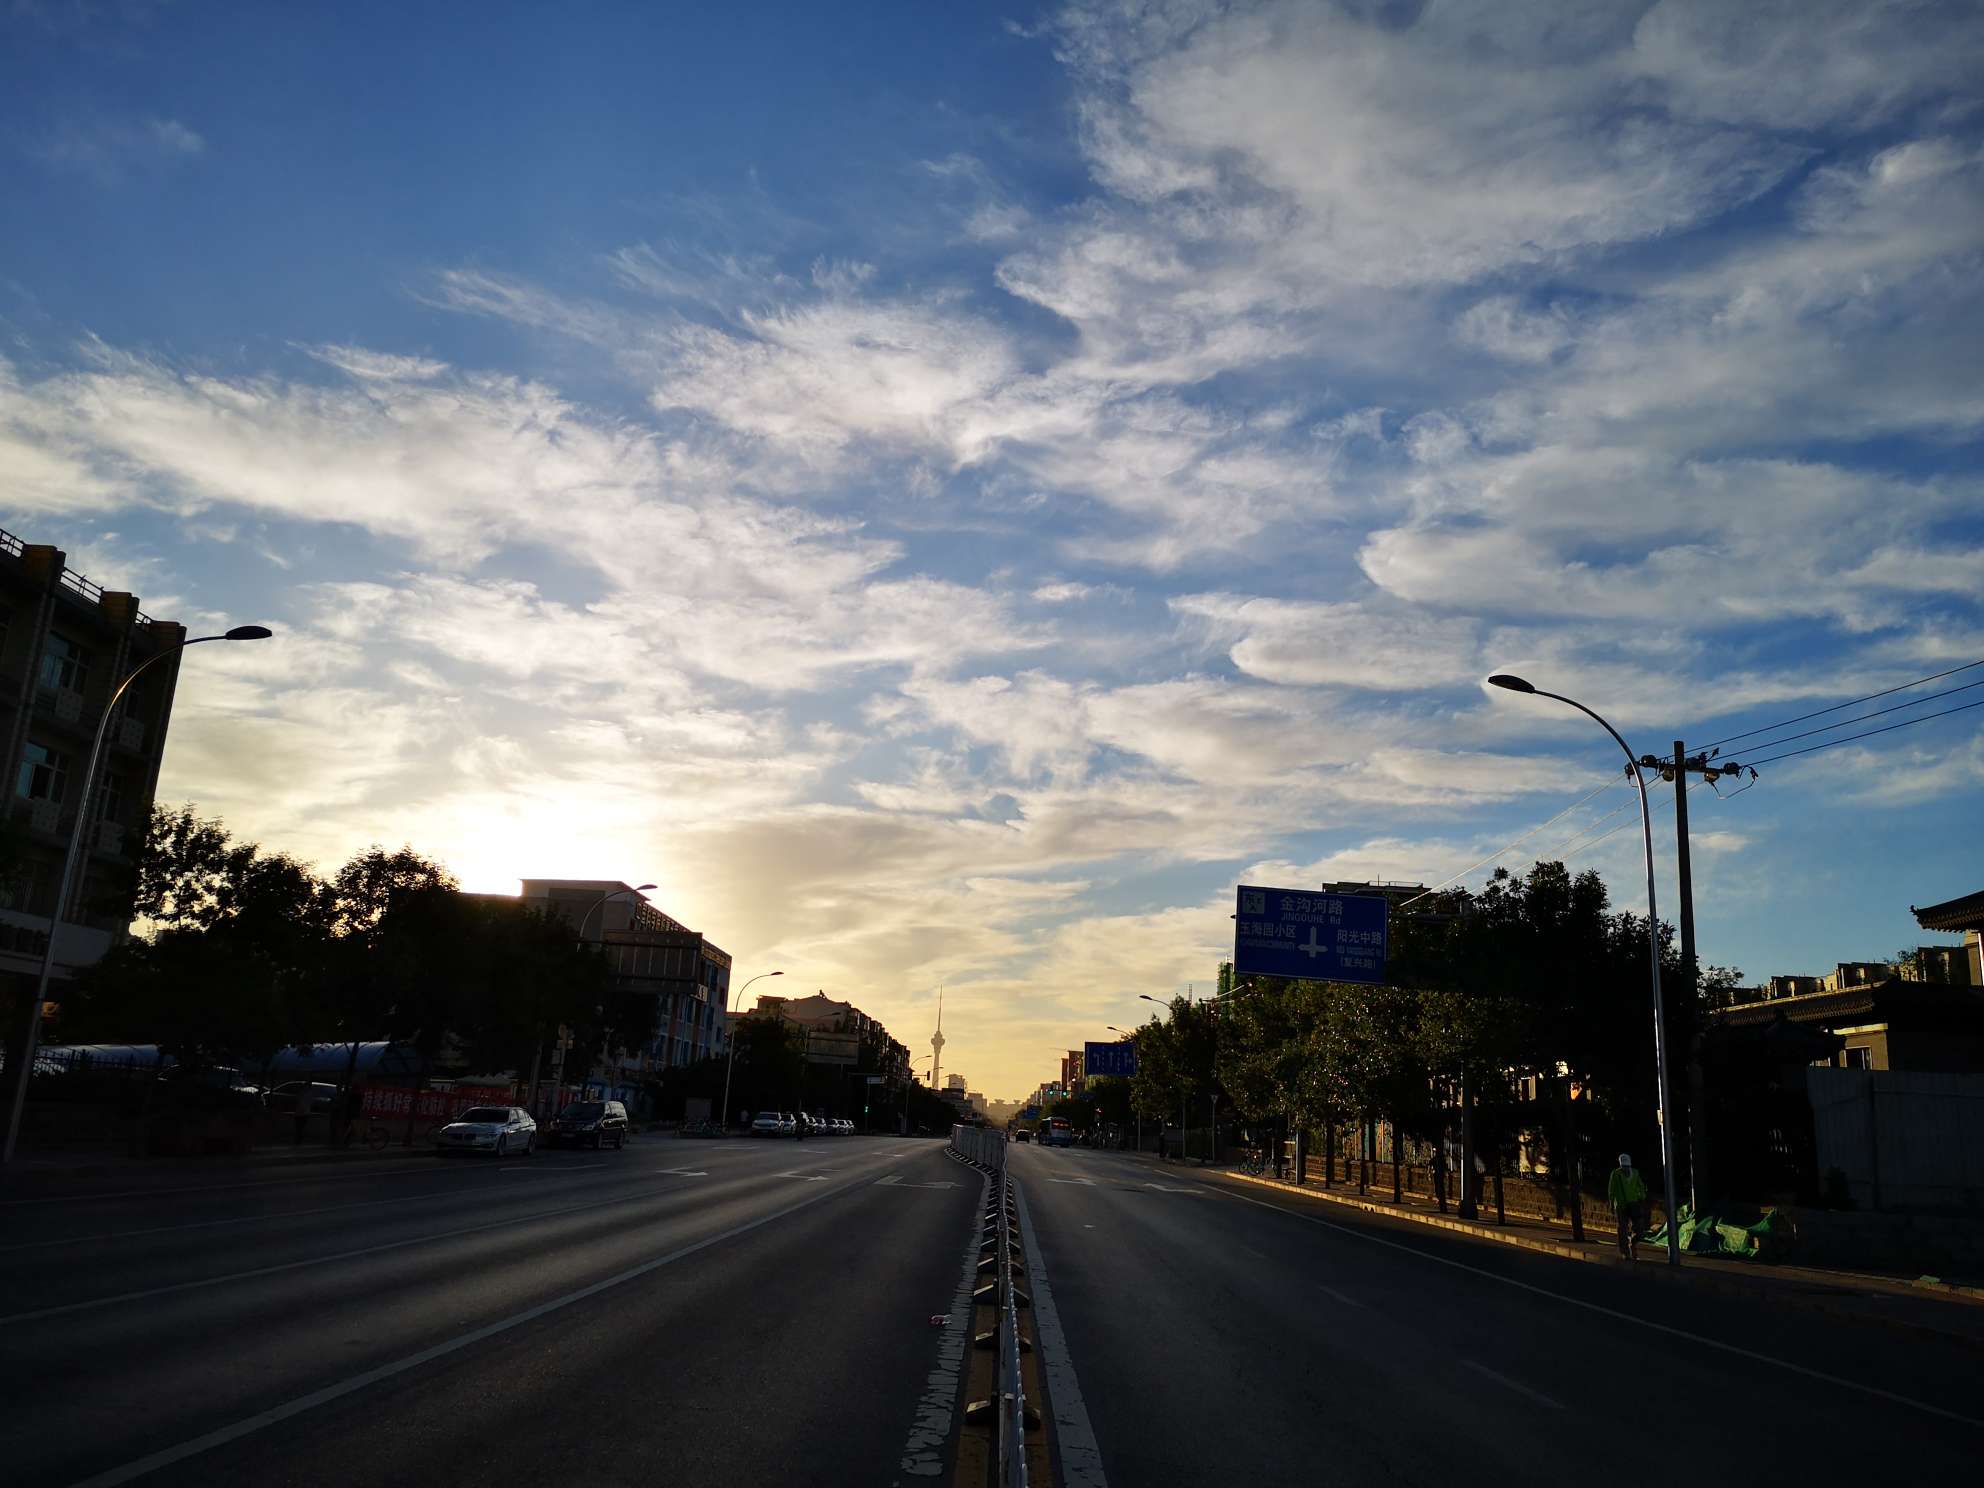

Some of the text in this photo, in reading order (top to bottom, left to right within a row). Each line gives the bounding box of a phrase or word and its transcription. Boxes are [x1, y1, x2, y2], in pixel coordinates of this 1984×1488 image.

[1280, 896, 1343, 915] 金沟河路
[1337, 929, 1382, 945] 阳光中路
